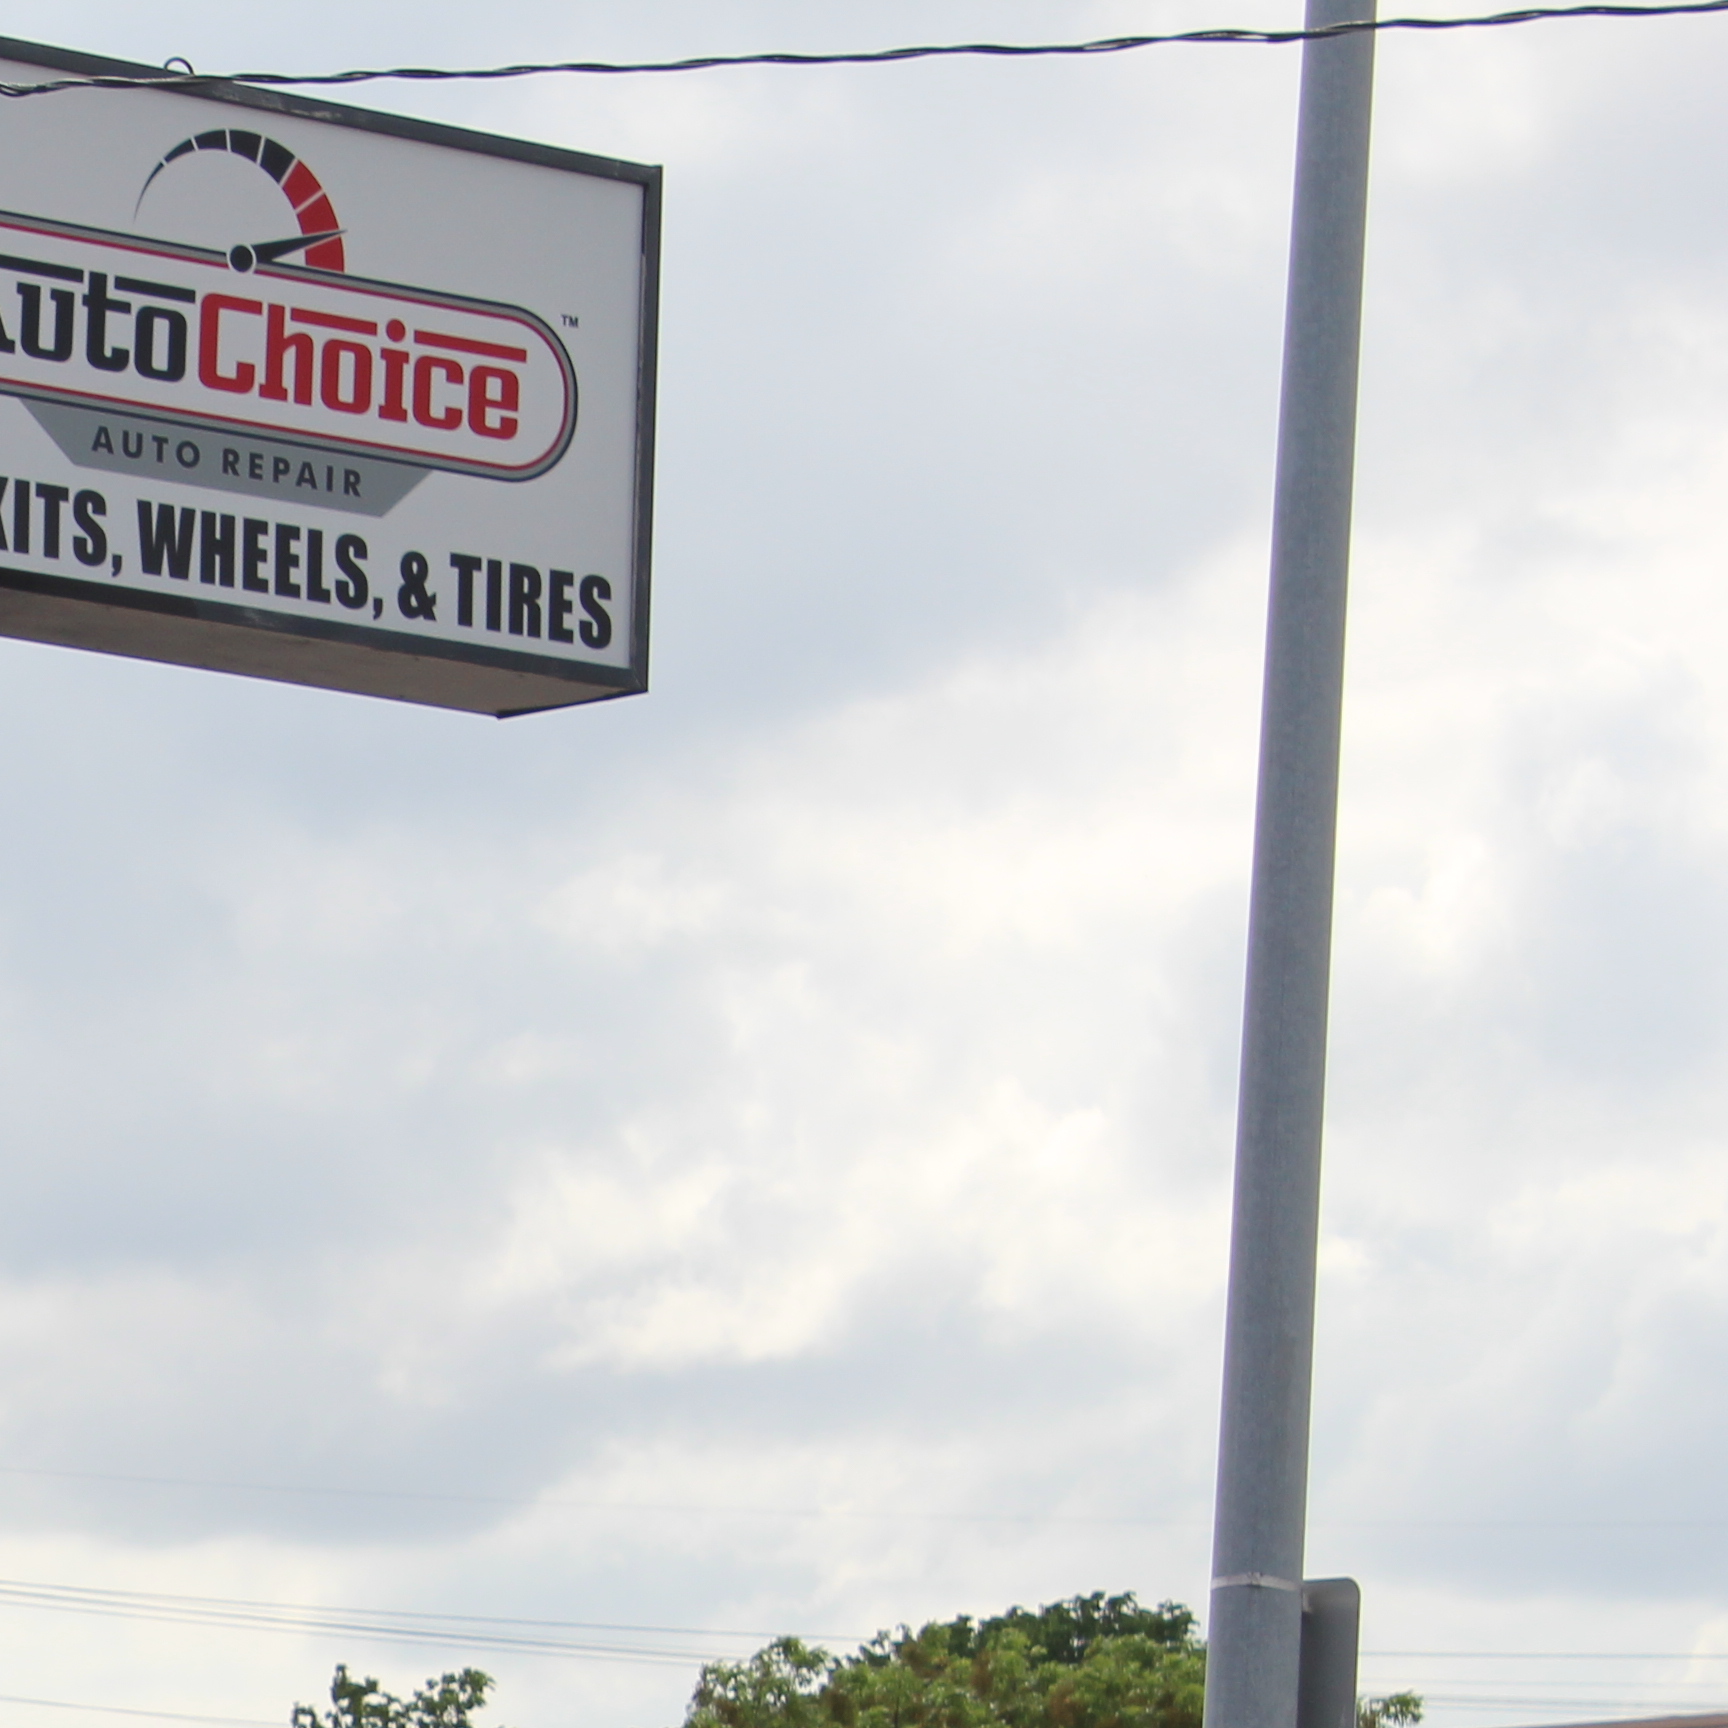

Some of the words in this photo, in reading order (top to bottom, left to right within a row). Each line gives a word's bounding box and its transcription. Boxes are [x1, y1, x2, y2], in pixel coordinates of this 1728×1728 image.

[91, 425, 203, 470] AUTO
[221, 448, 364, 498] REPAIR
[137, 498, 383, 621] WHEELS,
[396, 551, 437, 622] &
[450, 552, 613, 650] TIRES
